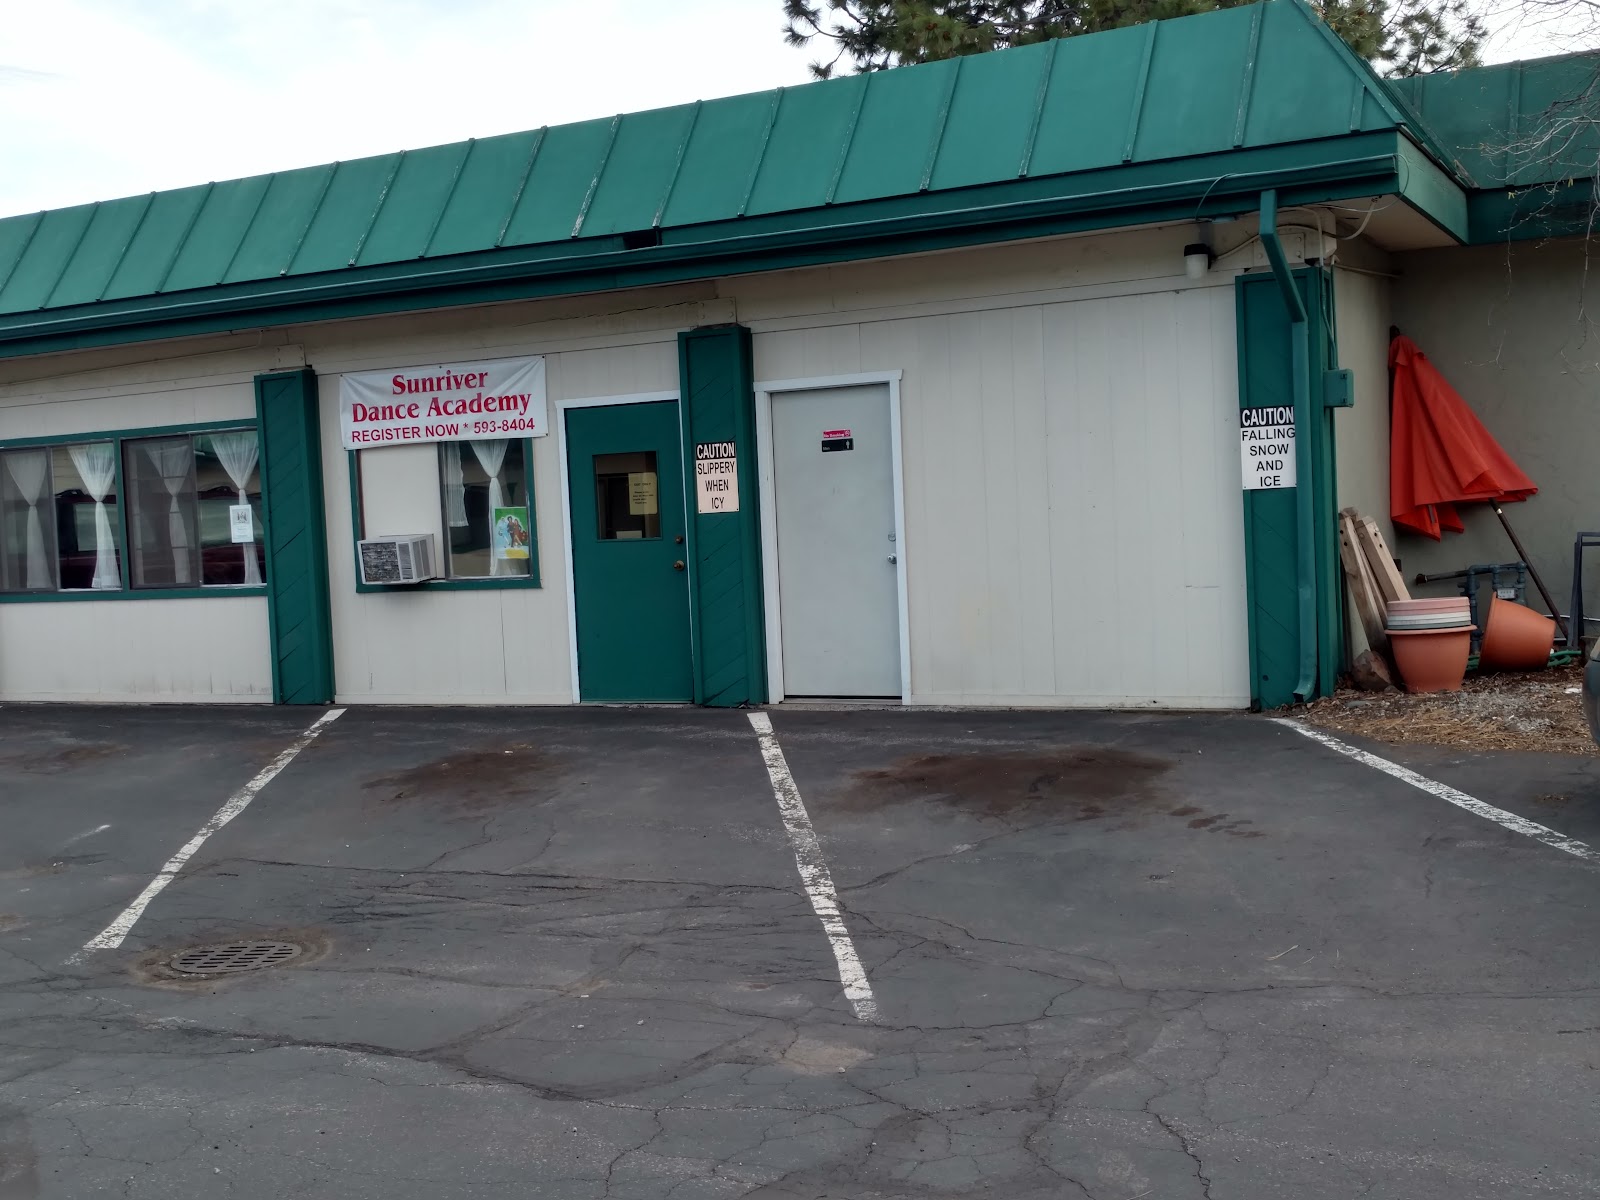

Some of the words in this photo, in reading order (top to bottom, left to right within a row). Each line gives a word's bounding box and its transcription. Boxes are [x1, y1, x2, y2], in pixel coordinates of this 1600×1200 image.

[392, 370, 488, 395] Sunriver
[352, 403, 420, 423] Dance
[427, 392, 532, 415] Academy
[1242, 406, 1294, 426] CAUTION
[352, 426, 421, 443] REGISTER
[425, 423, 459, 437] NOW
[473, 418, 535, 434] 593-8404
[1242, 428, 1295, 441] FALLING
[696, 442, 735, 459] CAUTION
[1249, 444, 1289, 456] SNOW
[697, 461, 735, 475] SLIPPERY
[1256, 460, 1283, 471] AND
[705, 479, 729, 492] WHEN
[1260, 476, 1281, 487] ICE
[711, 497, 725, 509] ICY
